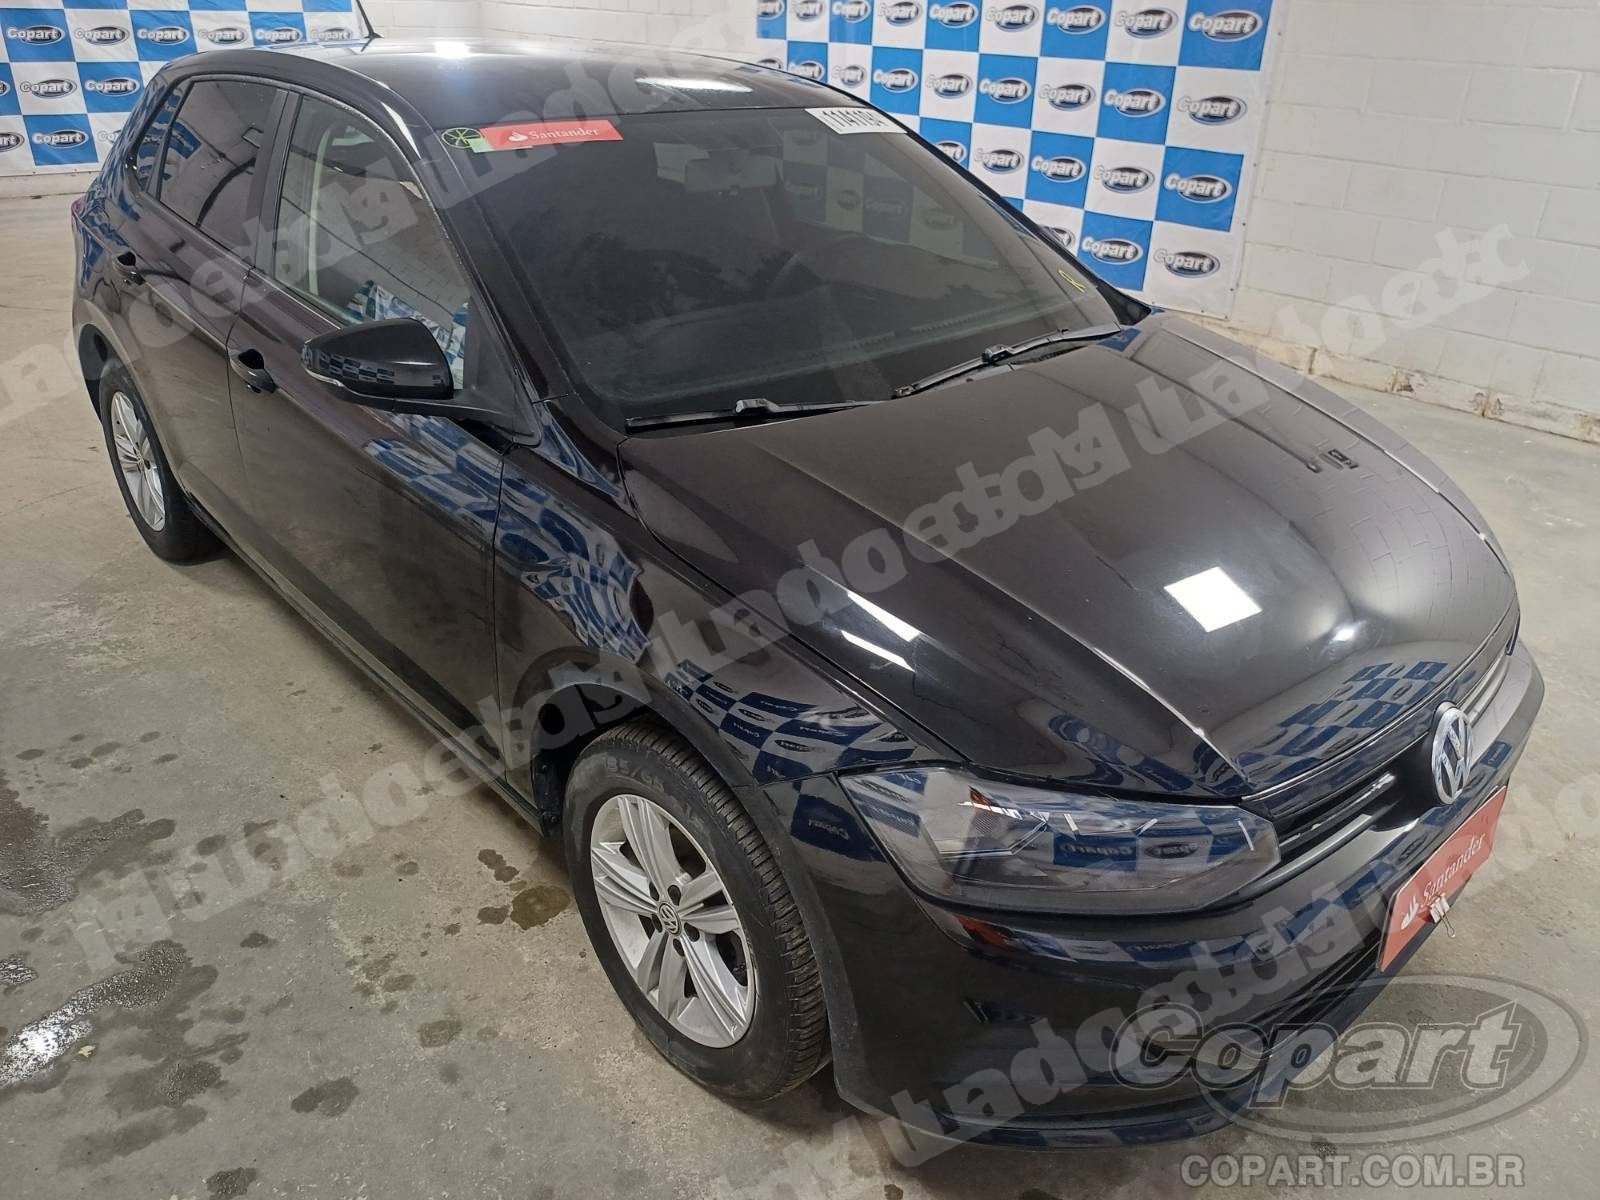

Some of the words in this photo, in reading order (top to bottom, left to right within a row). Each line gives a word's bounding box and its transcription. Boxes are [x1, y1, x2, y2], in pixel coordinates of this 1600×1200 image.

[929, 4, 974, 22] Copart
[986, 5, 1034, 26] Copart
[1047, 8, 1100, 28] Copart
[1115, 9, 1170, 32] Copart
[7, 27, 59, 40] Copart
[137, 27, 185, 40] Copart
[199, 28, 242, 40] Copart
[255, 28, 298, 40] Copart
[1188, 12, 1255, 36] Copart
[74, 28, 122, 41] Copart
[20, 80, 72, 95] Copart
[85, 80, 135, 93] Copart
[873, 69, 914, 87] Copart
[926, 75, 967, 93] Copart
[979, 79, 1028, 98] Copart
[1039, 84, 1088, 104] Copart
[1104, 89, 1159, 110] Copart
[1177, 97, 1238, 119] Copart
[32, 132, 82, 146] Copart
[528, 127, 600, 140] Santander
[975, 148, 1018, 168] Copart
[1031, 155, 1080, 176] Copart
[1094, 165, 1147, 187] Copart
[1164, 173, 1223, 198] Copart
[1081, 237, 1136, 260] Copart
[1153, 248, 1212, 273] Copart
[1420, 833, 1486, 907] Santander
